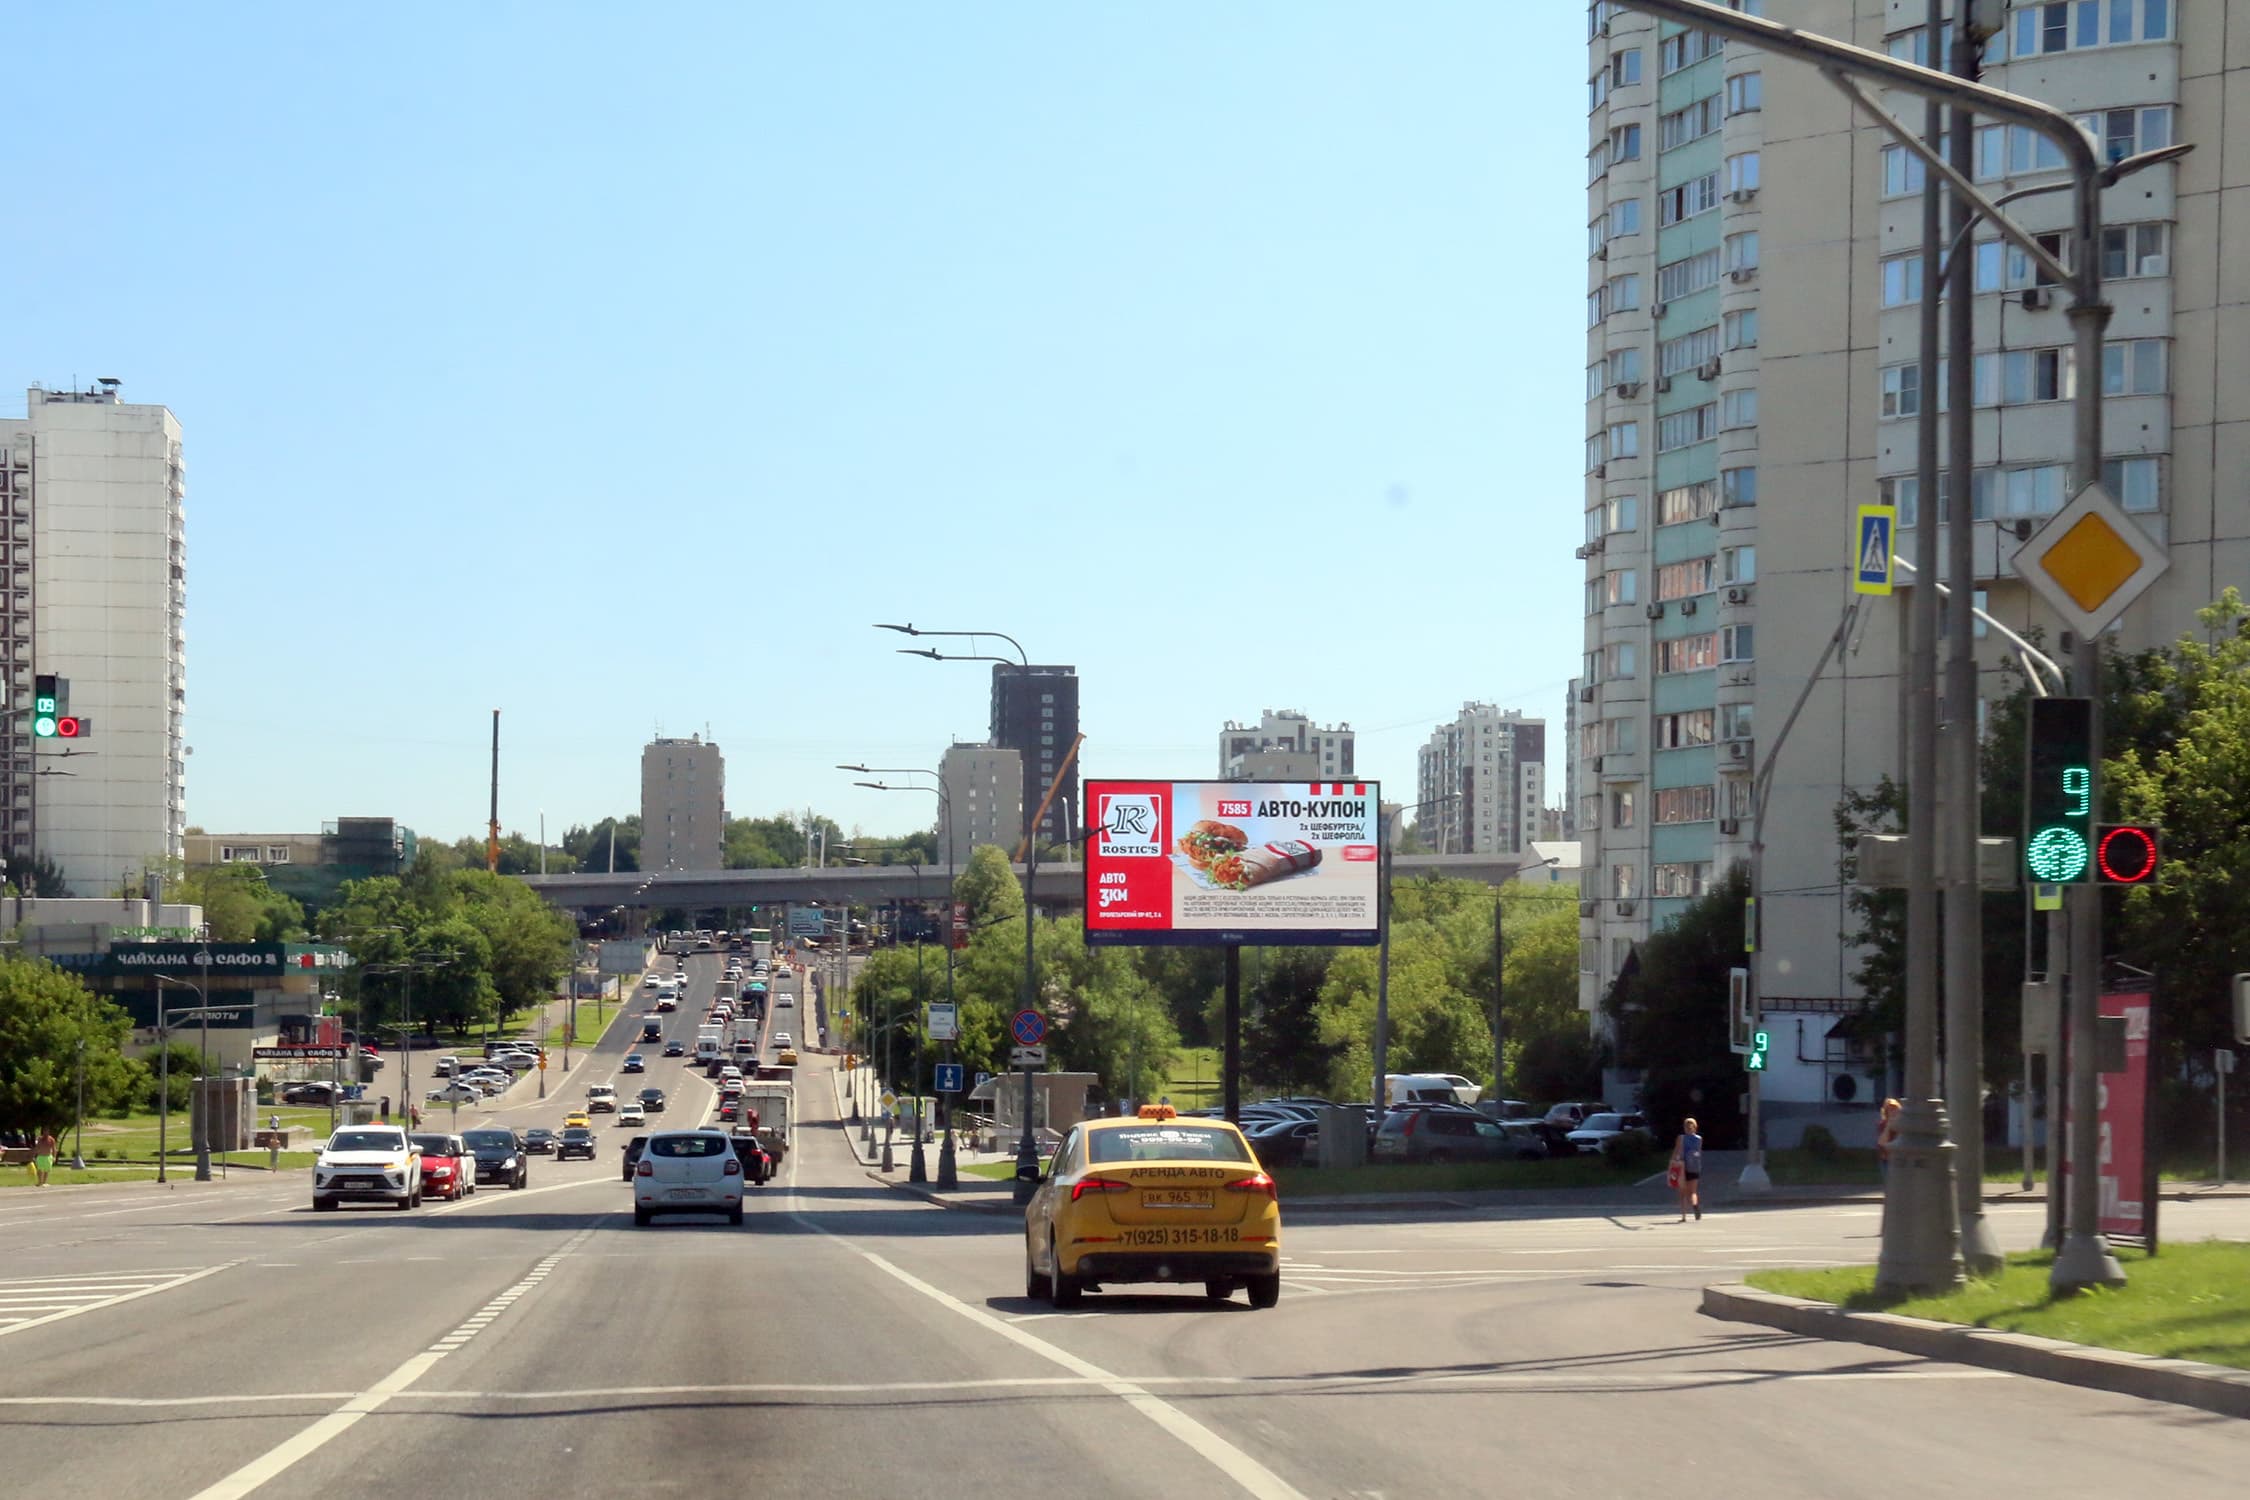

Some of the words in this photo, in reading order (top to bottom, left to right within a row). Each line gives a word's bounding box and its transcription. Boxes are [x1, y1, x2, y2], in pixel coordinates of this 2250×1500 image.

[2063, 768, 2089, 815] 9
[1222, 803, 1247, 815] 7585
[1258, 801, 1365, 817] АВТО-КУПОН
[1322, 832, 1365, 840] ШЕФРОЛЛА
[1102, 846, 1159, 854] ROSTIC'S
[1099, 873, 1126, 884] АВТО
[117, 952, 188, 965] ЧАЙХАНА
[216, 954, 262, 966] САФО
[1755, 1033, 1767, 1051] 9
[1130, 1168, 1185, 1178] АРЕНДА
[1190, 1168, 1225, 1178] АВТО
[1173, 1228, 1239, 1243] 315-18-18
